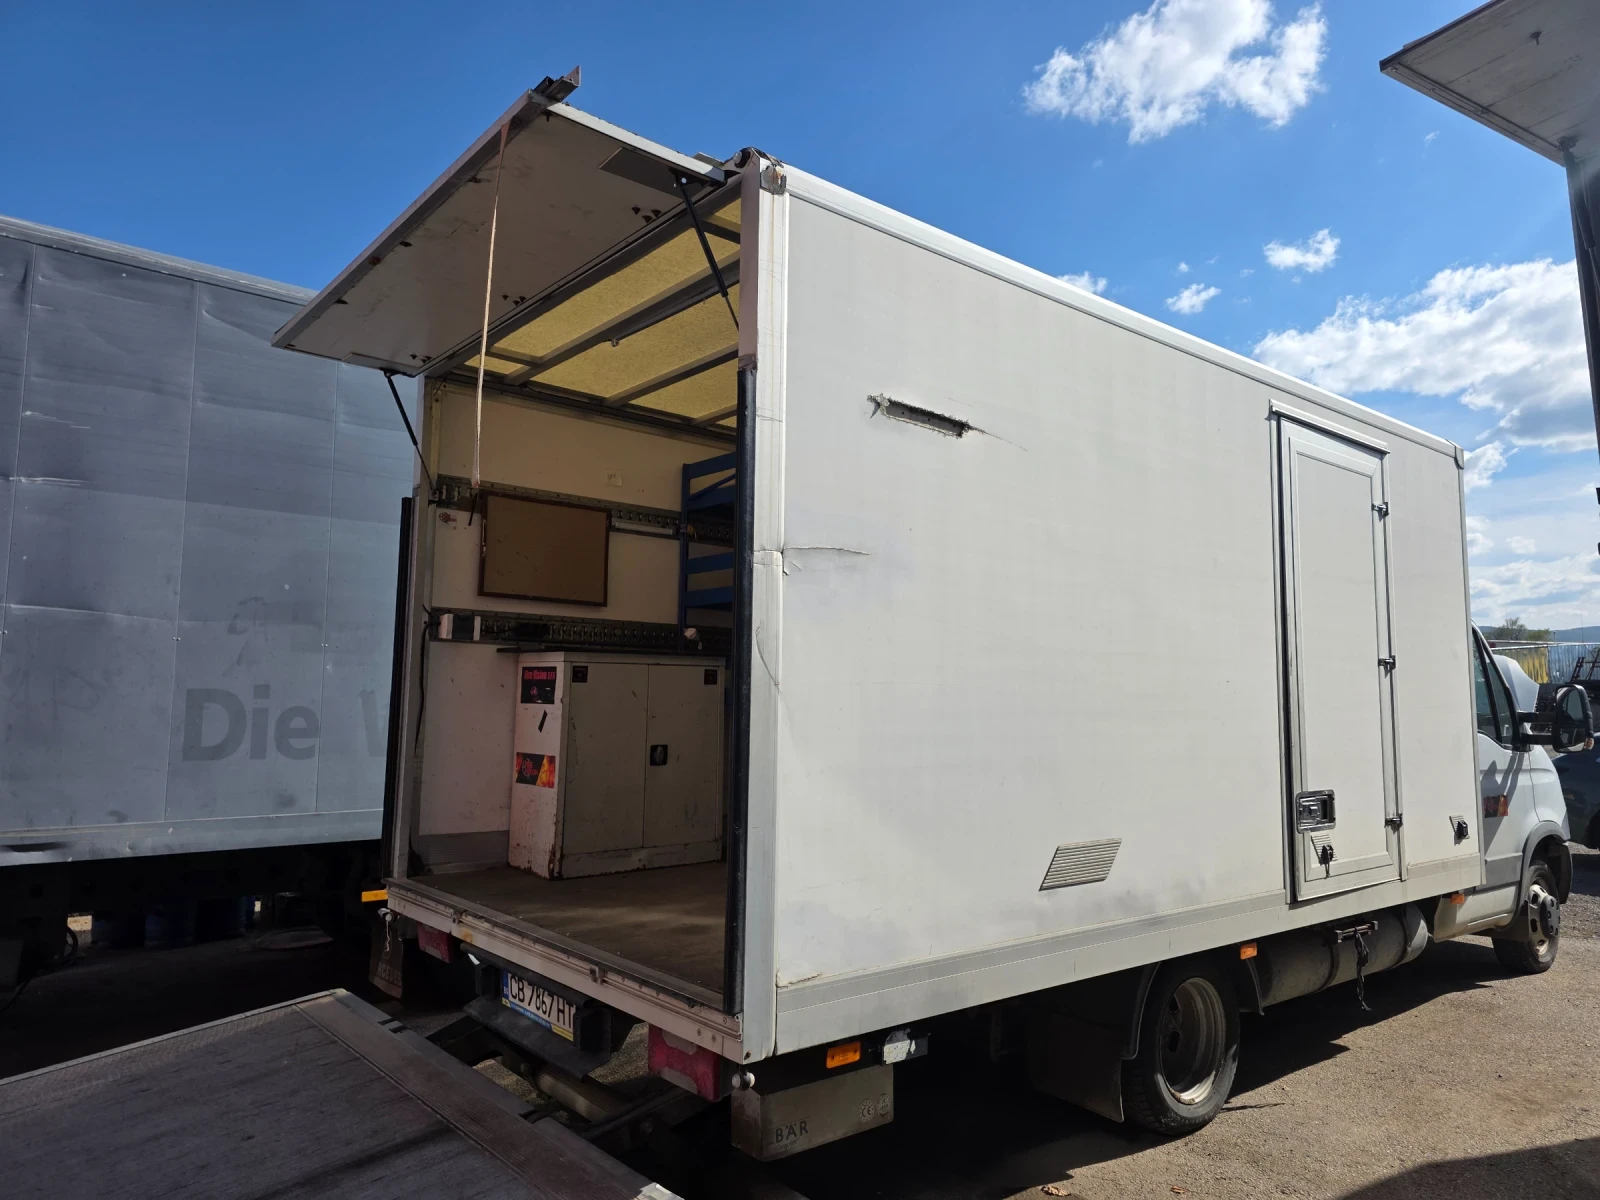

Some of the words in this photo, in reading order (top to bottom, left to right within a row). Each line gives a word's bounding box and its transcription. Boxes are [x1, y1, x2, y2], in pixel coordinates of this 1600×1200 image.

[182, 684, 321, 762] Die
[510, 974, 525, 1004] CB
[527, 982, 555, 1018] 7867
[557, 996, 574, 1029] HT
[775, 1120, 809, 1143] BÄR
